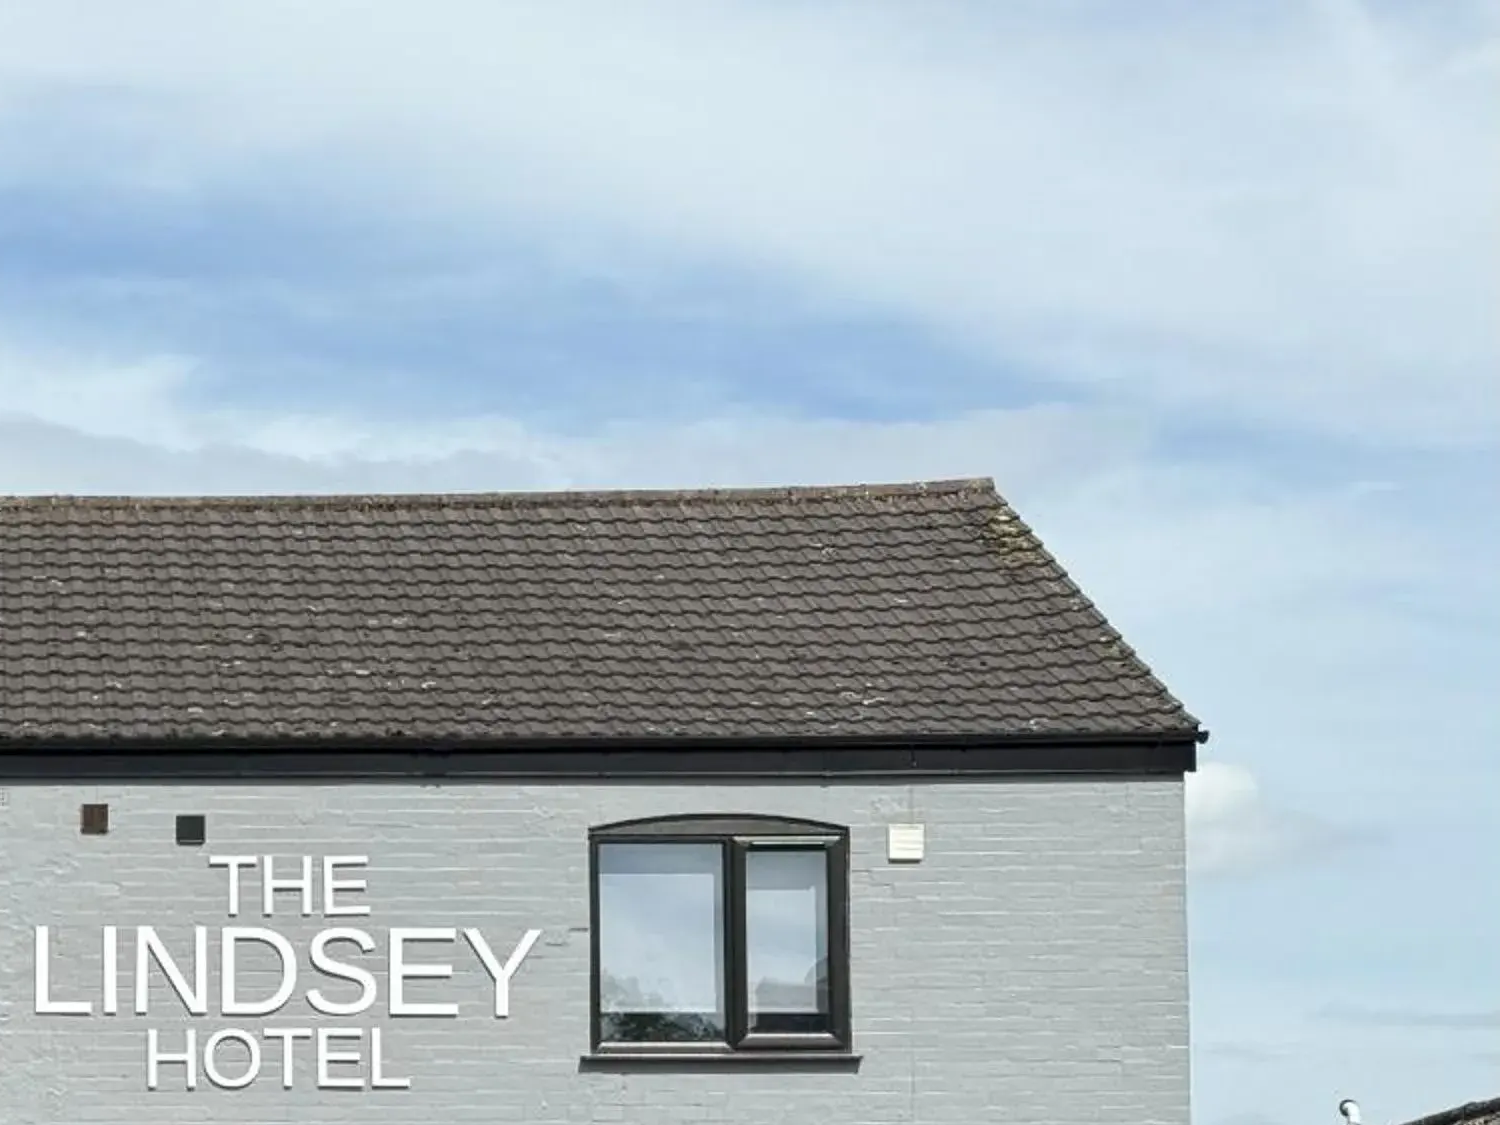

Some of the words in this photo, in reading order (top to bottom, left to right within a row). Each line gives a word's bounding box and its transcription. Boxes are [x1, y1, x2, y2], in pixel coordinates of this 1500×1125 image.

[208, 855, 371, 917] THE
[35, 925, 542, 1018] LINDSEY
[147, 1027, 411, 1091] HOTEL
